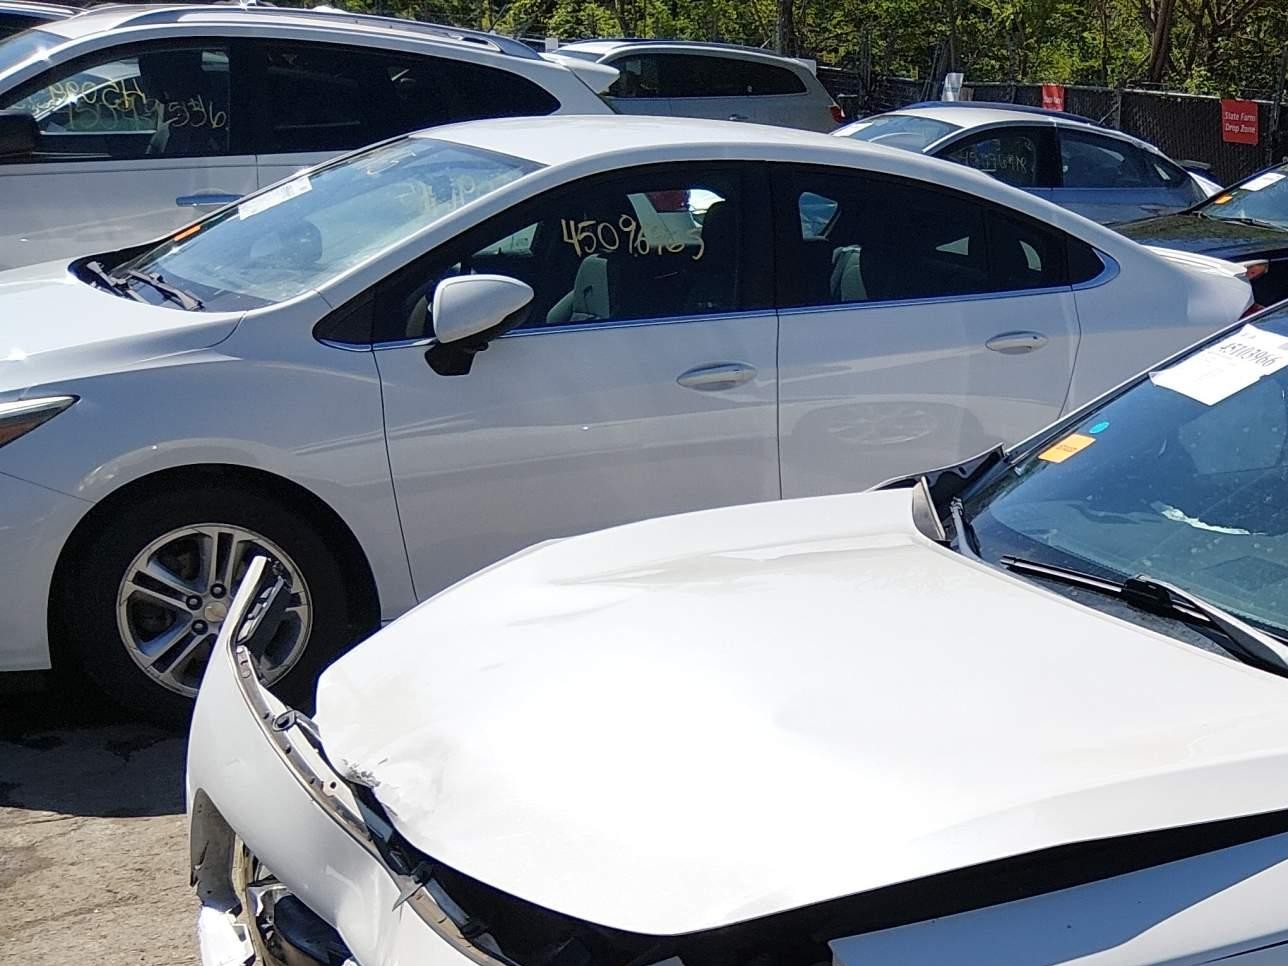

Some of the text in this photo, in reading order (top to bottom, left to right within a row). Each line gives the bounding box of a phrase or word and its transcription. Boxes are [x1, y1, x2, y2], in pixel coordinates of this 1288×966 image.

[1224, 111, 1256, 122] State Farm
[1225, 123, 1256, 134] Drop Zone
[1220, 342, 1281, 368] 45103966
